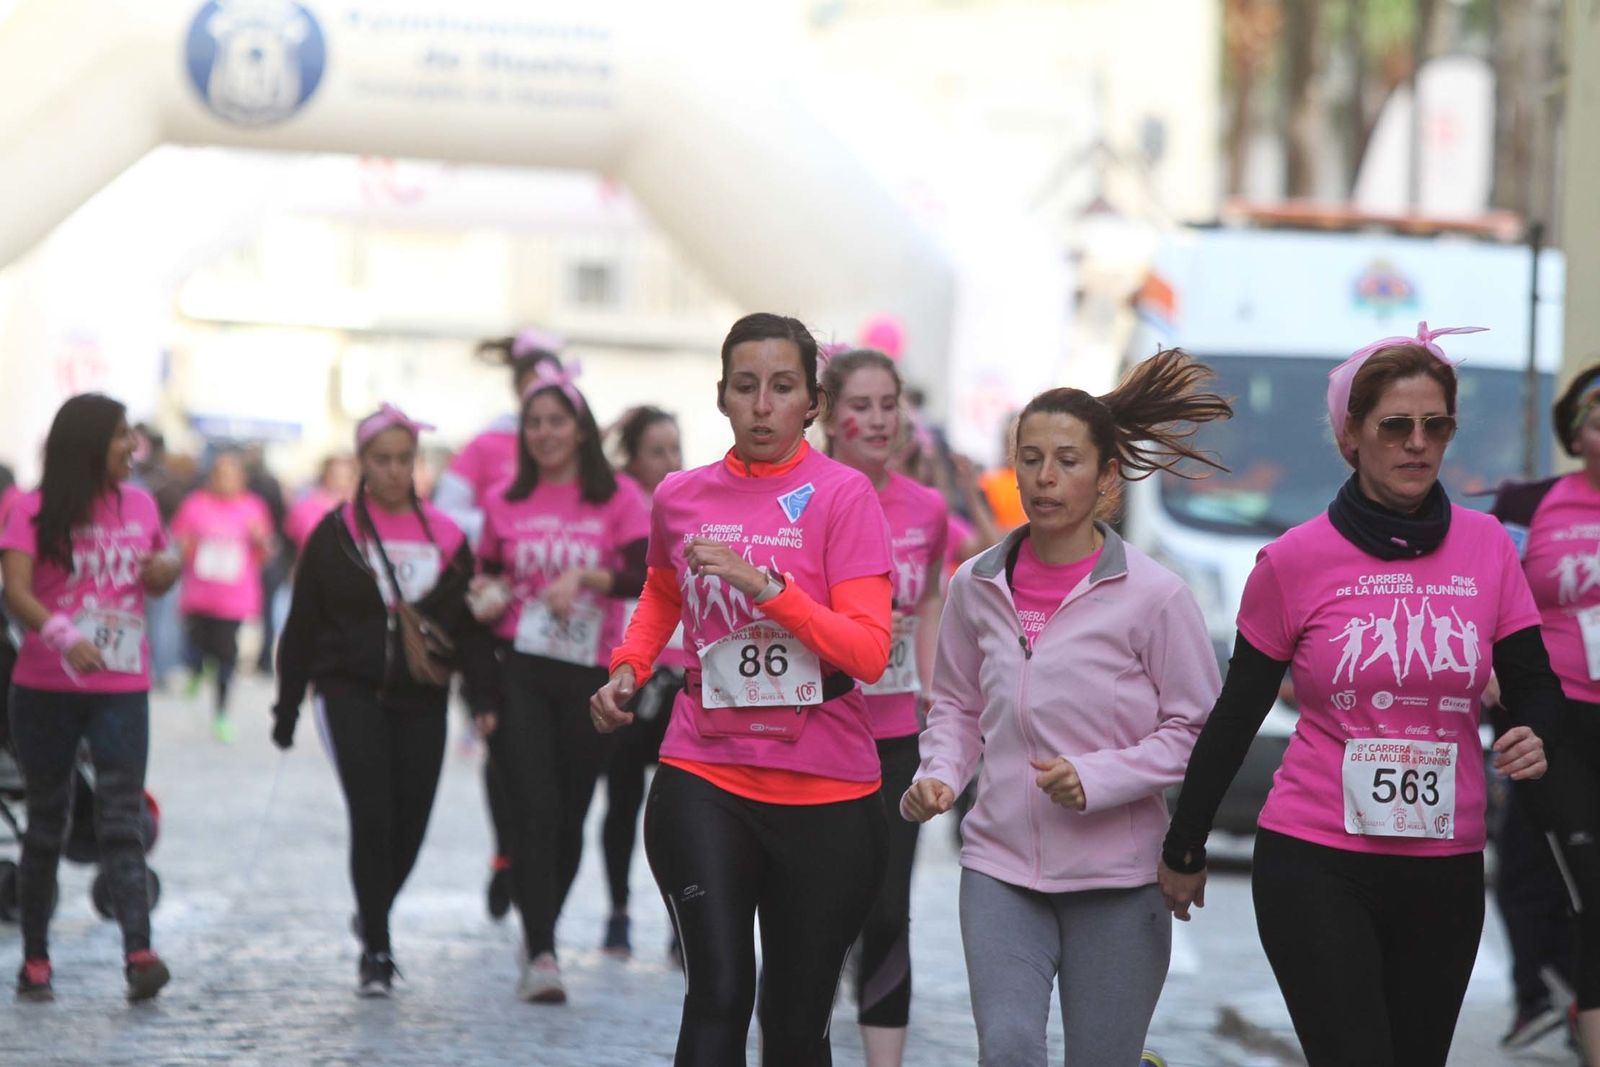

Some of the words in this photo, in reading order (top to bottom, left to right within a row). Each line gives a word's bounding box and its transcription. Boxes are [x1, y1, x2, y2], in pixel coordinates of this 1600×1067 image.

[701, 524, 743, 533] CARRERA
[778, 528, 803, 538] PINK
[708, 533, 741, 543] MUJER
[752, 535, 803, 549] RUNNING
[1358, 574, 1414, 585] CARRERA
[1451, 575, 1476, 587] PINK
[1336, 587, 1351, 596] DE
[1355, 586, 1369, 596] LA
[1373, 584, 1414, 595] MUJER
[1426, 585, 1478, 597] RUNNING
[1018, 610, 1046, 622] RRERA
[1021, 621, 1044, 632] UJER
[739, 644, 788, 677] 86
[1368, 744, 1411, 754] CARRERA
[1351, 753, 1362, 762] DE
[1365, 753, 1376, 762] LA
[1380, 753, 1410, 764] MUJER
[1419, 756, 1451, 767] RUNNING
[1372, 768, 1440, 806] 563
